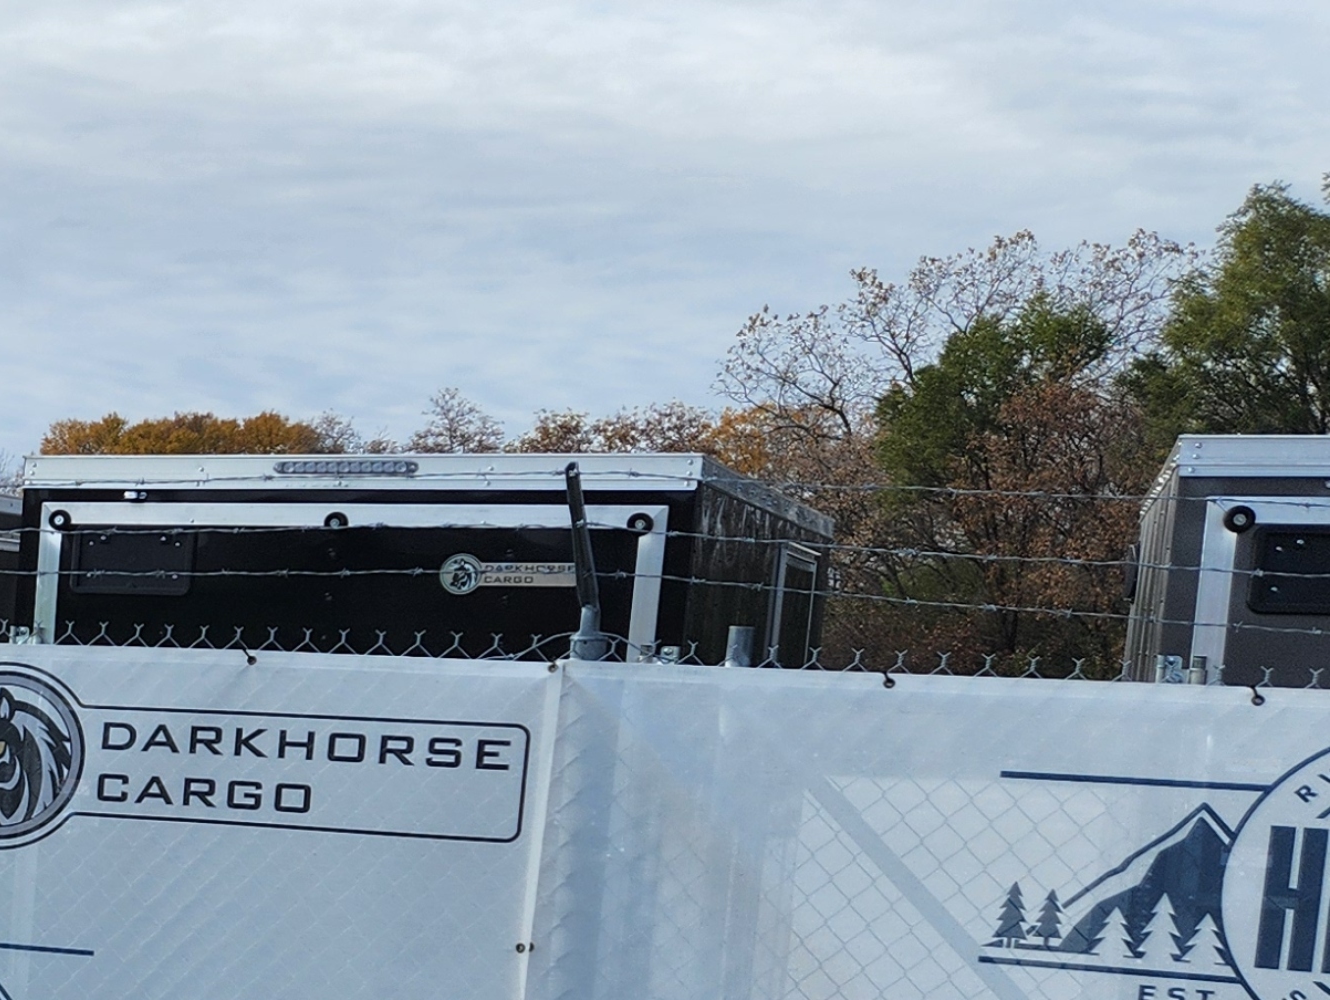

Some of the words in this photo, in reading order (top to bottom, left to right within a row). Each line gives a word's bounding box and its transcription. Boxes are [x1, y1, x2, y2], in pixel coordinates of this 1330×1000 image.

[484, 575, 534, 584] CARGO
[100, 721, 512, 771] DARKHORSE
[96, 772, 312, 814] CARGO
